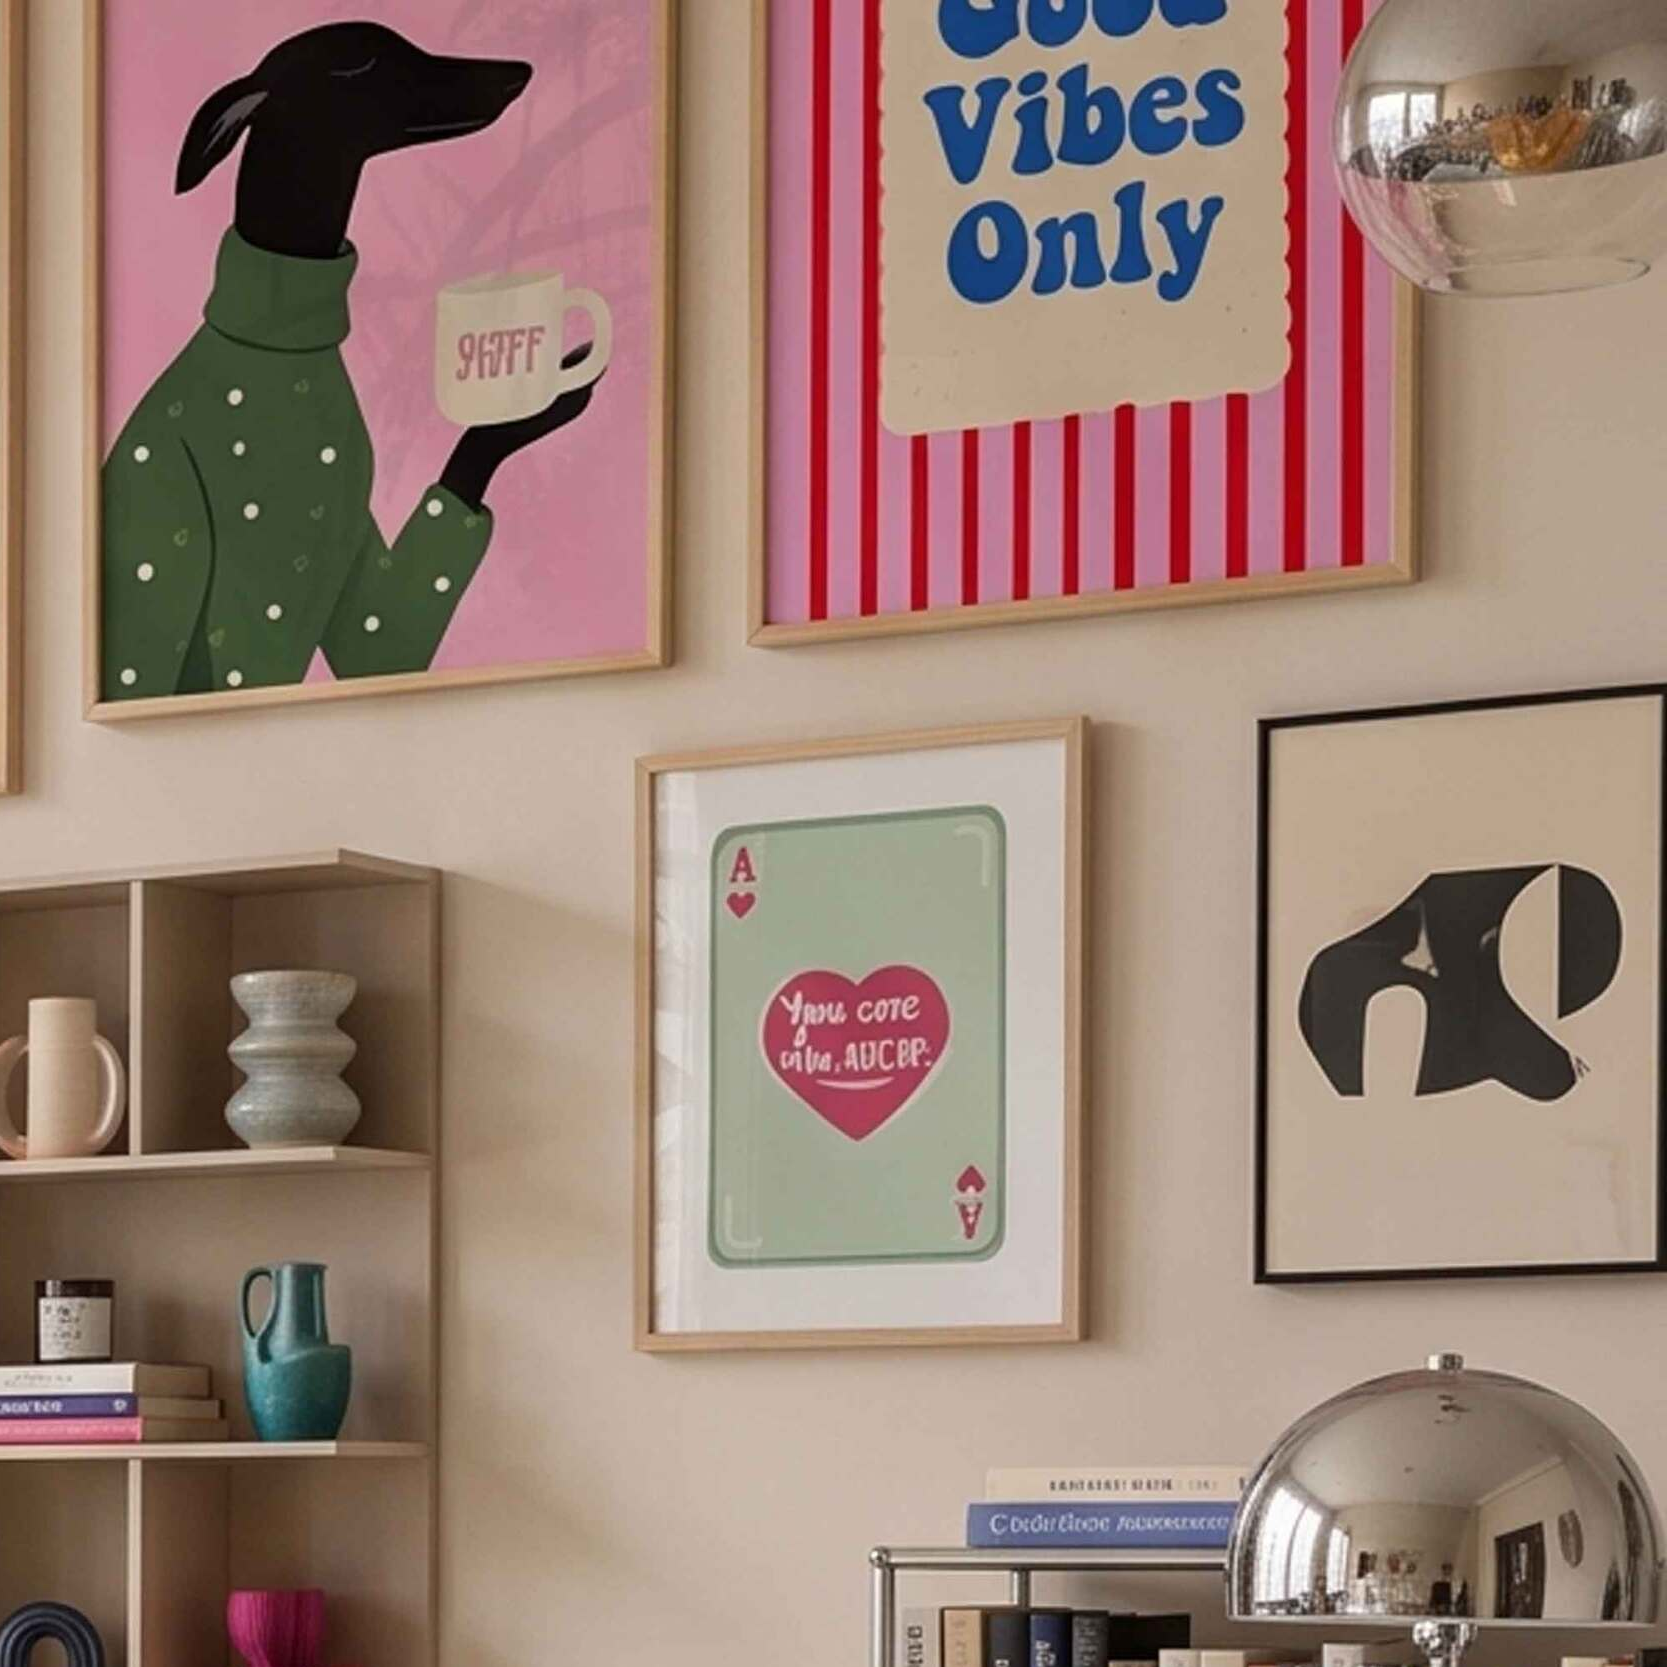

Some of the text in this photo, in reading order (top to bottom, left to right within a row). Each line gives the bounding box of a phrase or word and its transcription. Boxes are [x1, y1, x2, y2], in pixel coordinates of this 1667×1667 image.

[938, 0, 1228, 59] Go
[923, 62, 1246, 185] Vibes
[947, 180, 1224, 304] Only
[730, 846, 757, 883] A
